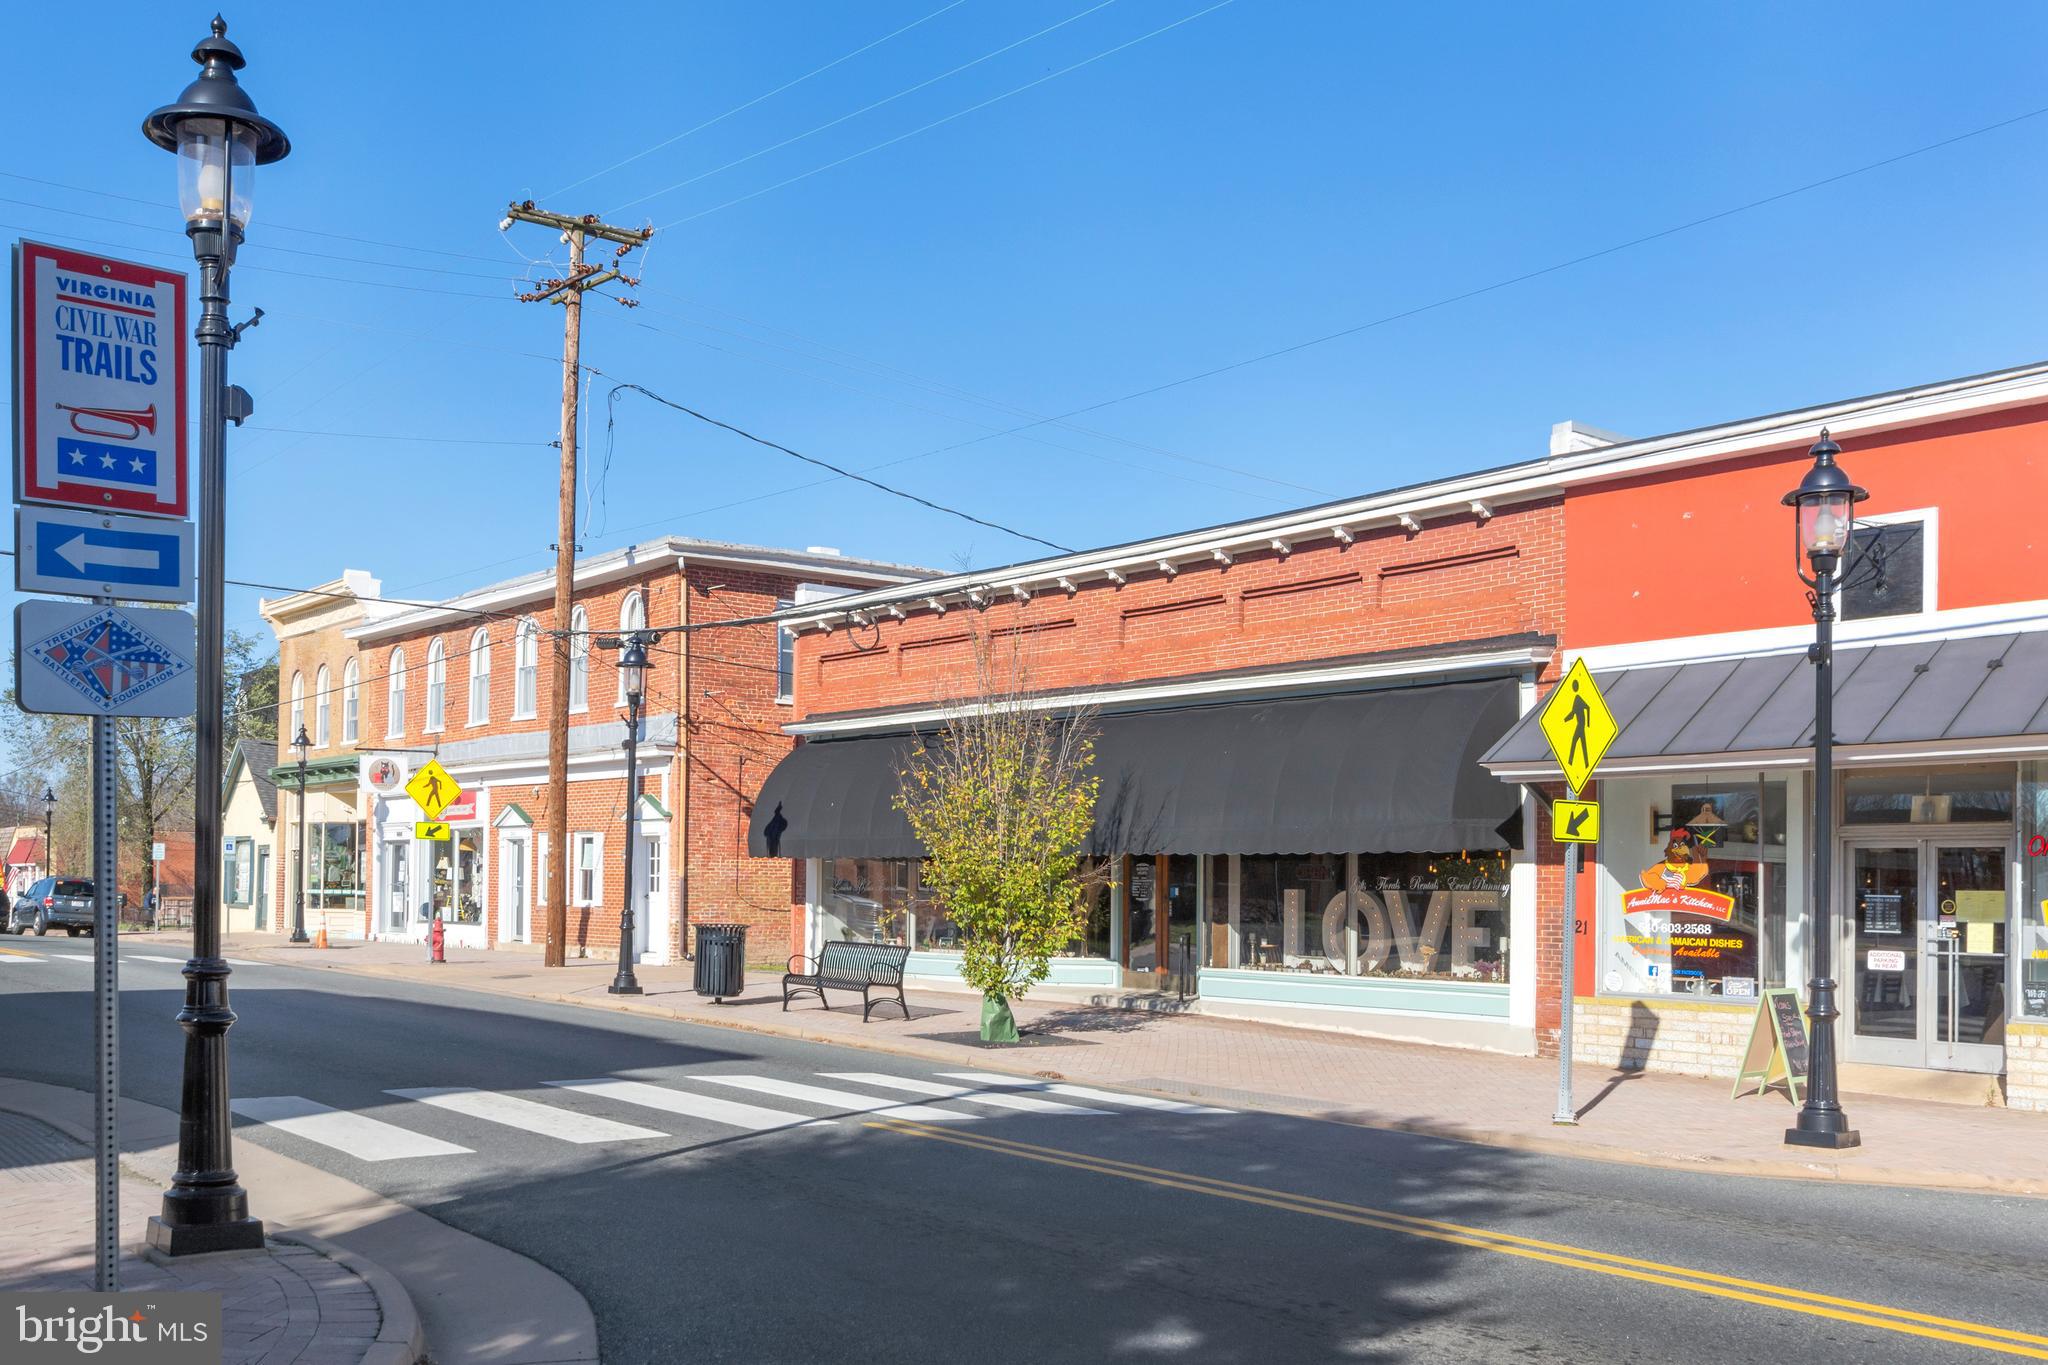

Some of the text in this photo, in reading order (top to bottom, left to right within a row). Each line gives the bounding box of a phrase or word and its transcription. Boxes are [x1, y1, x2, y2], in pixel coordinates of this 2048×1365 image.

[56, 276, 156, 309] VIRGINIA
[55, 304, 157, 347] CIVIL WAR
[56, 333, 158, 385] TRAILS
[44, 615, 172, 659] TREVILIAN STATION
[42, 656, 175, 705] BATTLEFIELD FOUNDATION
[1409, 875, 1438, 890] Rentals
[1448, 876, 1470, 890] Event
[1472, 876, 1511, 897] Planning
[1284, 889, 1499, 977] LOVE
[1664, 937, 1708, 947] JAMAICAN
[1709, 939, 1743, 948] DISHES
[1674, 946, 1720, 958] Available
[1727, 987, 1750, 996] OPEN
